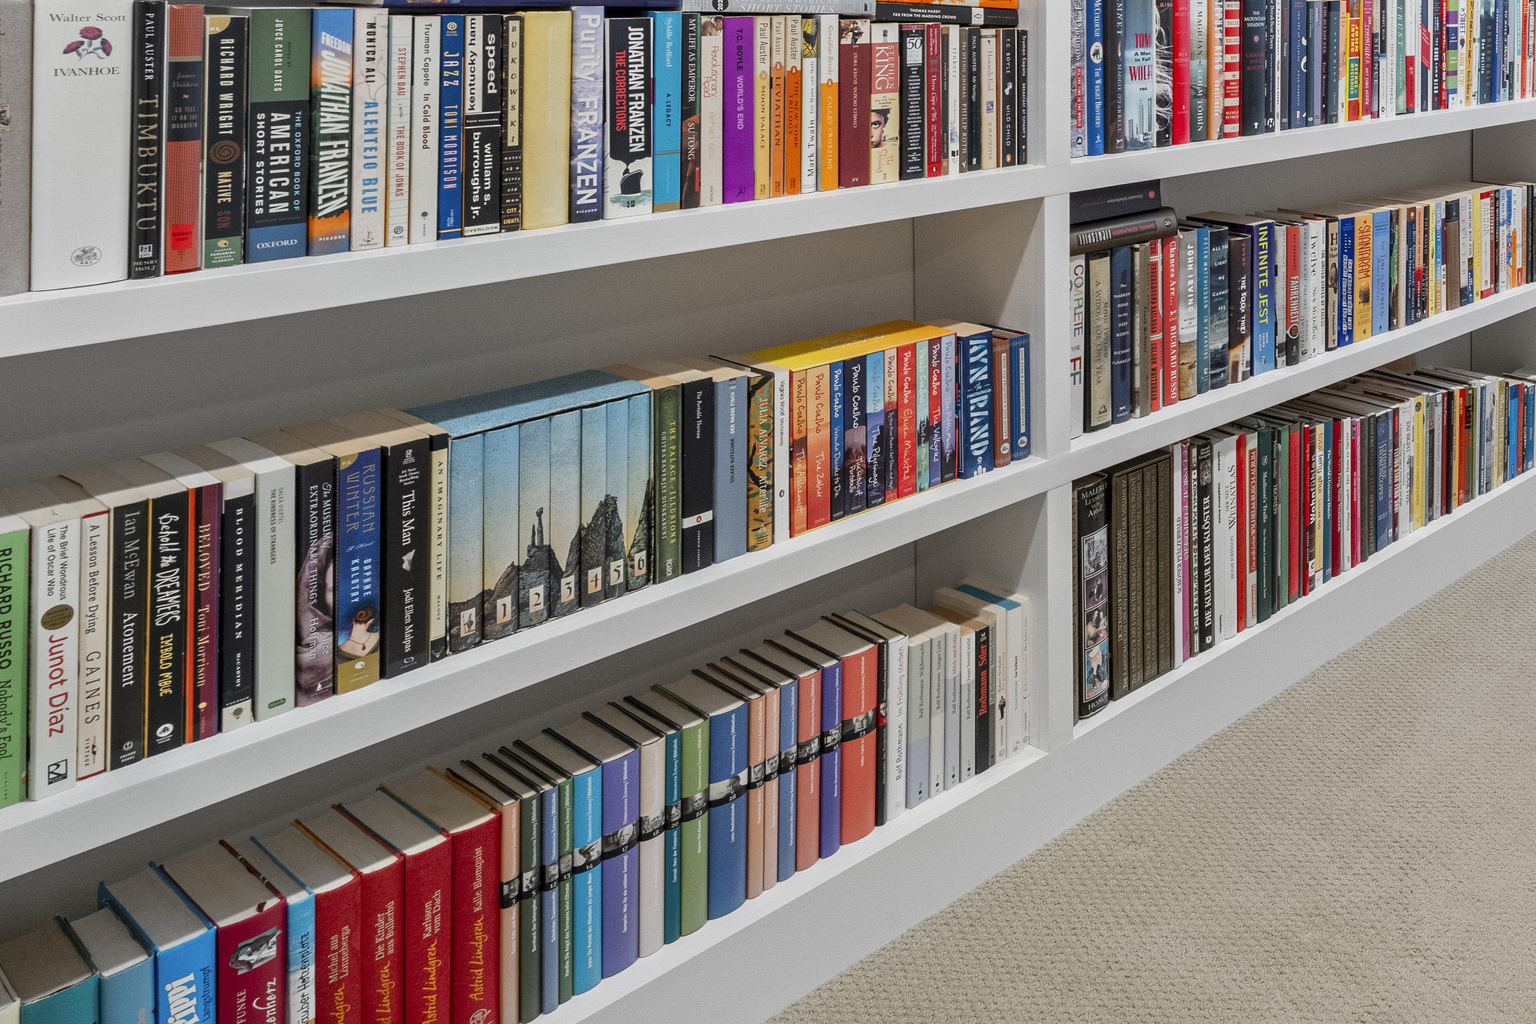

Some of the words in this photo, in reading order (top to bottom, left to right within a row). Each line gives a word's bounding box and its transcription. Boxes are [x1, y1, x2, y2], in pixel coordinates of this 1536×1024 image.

[50, 14, 92, 22] Walter
[96, 13, 126, 22] Scott
[146, 13, 154, 39] PAUL
[365, 23, 376, 63] MONICA
[424, 23, 432, 53] Truman
[579, 15, 600, 82] Purity
[1214, 46, 1222, 70] KING
[54, 67, 119, 76] IVANHOE
[145, 42, 154, 80] AUSTER
[365, 65, 374, 84] ALI
[423, 57, 431, 86] Capote
[444, 52, 458, 86] JAZZ
[487, 34, 497, 93] speed
[616, 50, 626, 68] THE
[628, 26, 644, 93] JONATHAN
[875, 45, 889, 90] KING
[444, 105, 458, 131] TONI
[616, 71, 626, 131] CORRECTIONS
[257, 114, 265, 155] SHORT
[363, 102, 378, 170] ALENTEJO
[629, 99, 644, 152] FRANZEN
[137, 95, 159, 231] TIMBUKTU
[269, 113, 290, 213] AMERICAN
[443, 136, 457, 189] MORRISON
[470, 132, 481, 202] burroughs
[577, 99, 598, 205] FRANZEN
[256, 161, 264, 214] STORIES
[361, 178, 378, 214] BLUE
[470, 204, 478, 218] jr.
[257, 239, 297, 249] OXFORD
[1258, 226, 1268, 287] INFINITE
[1358, 226, 1371, 280] SHANTARAM
[1258, 294, 1268, 324] JEST
[969, 339, 988, 384] AYN
[969, 394, 990, 456] RAND
[346, 472, 359, 533] WINTER
[362, 464, 375, 533] RUSSIAN
[402, 490, 416, 517] This
[1202, 495, 1210, 540] KLÖSTER
[125, 511, 140, 538] Ian
[402, 520, 414, 546] Man
[198, 523, 210, 591] BELOVED
[612, 564, 622, 581] 5
[638, 554, 644, 571] 6
[1203, 544, 1211, 562] DER
[532, 592, 542, 608] 2
[564, 582, 572, 597] 3
[590, 573, 599, 589] 4
[1204, 568, 1212, 609] KULTUR
[198, 605, 210, 632] Toni
[501, 602, 507, 618] 1
[1204, 610, 1212, 627] DIE
[49, 635, 67, 689] Junot
[122, 613, 136, 687] Atonement
[198, 635, 210, 687] Morrison
[979, 644, 987, 666] Stier
[85, 651, 100, 724] GAINES
[979, 670, 987, 716] Rothmann
[474, 846, 484, 888] Blomquist
[474, 890, 482, 912] Kalle
[475, 914, 488, 969] Lindgren
[468, 969, 484, 1001] Astrid
